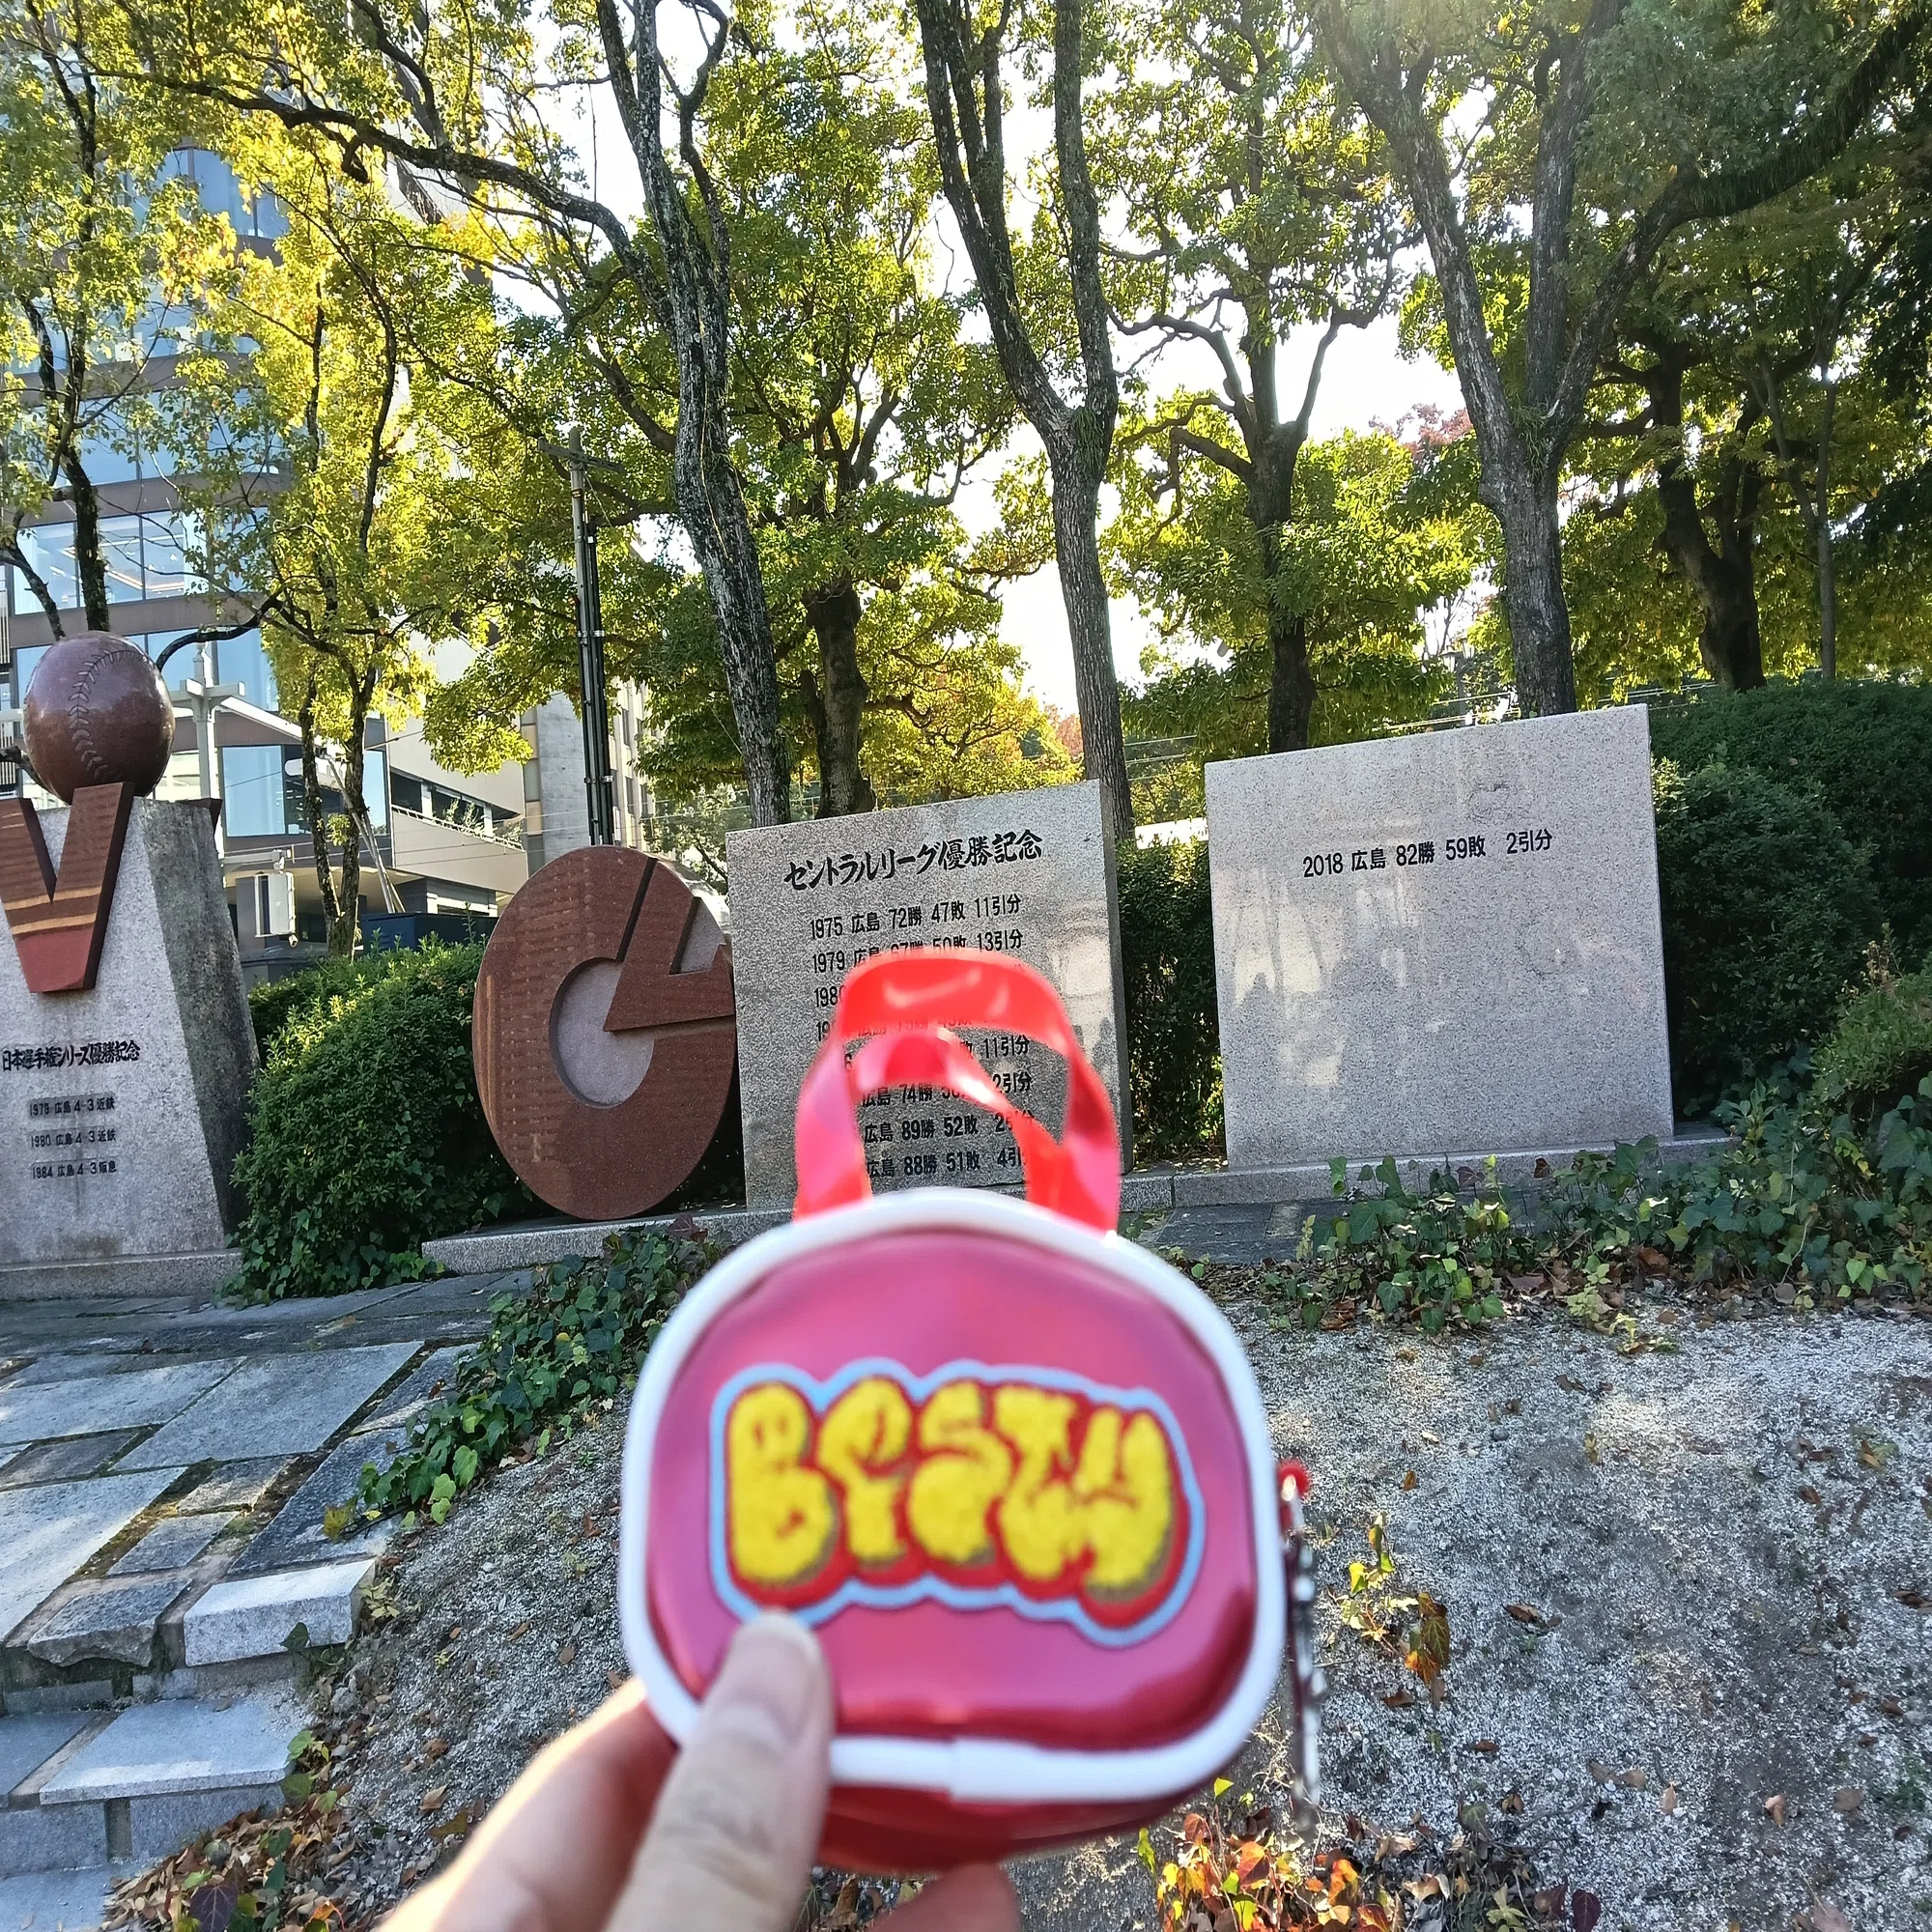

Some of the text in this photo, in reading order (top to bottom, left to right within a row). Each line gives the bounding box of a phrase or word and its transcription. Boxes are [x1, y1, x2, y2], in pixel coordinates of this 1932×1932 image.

[783, 829, 1043, 891] セントラルリーグ優勝記念
[1303, 828, 1553, 878] 2018 広島 82勝 59敗 2引分
[810, 893, 1022, 940] 1975 広島 72勝 47敗 11引分
[811, 950, 846, 974] 1979
[976, 928, 1024, 952] 13引分
[983, 1034, 1030, 1060] 11引分
[992, 1071, 1033, 1094] 2引分
[864, 1122, 895, 1145] 広島
[901, 1118, 936, 1141] 89勝
[943, 1115, 979, 1138] 52敗
[903, 1153, 938, 1177] 88勝
[946, 1151, 980, 1173] 51敗
